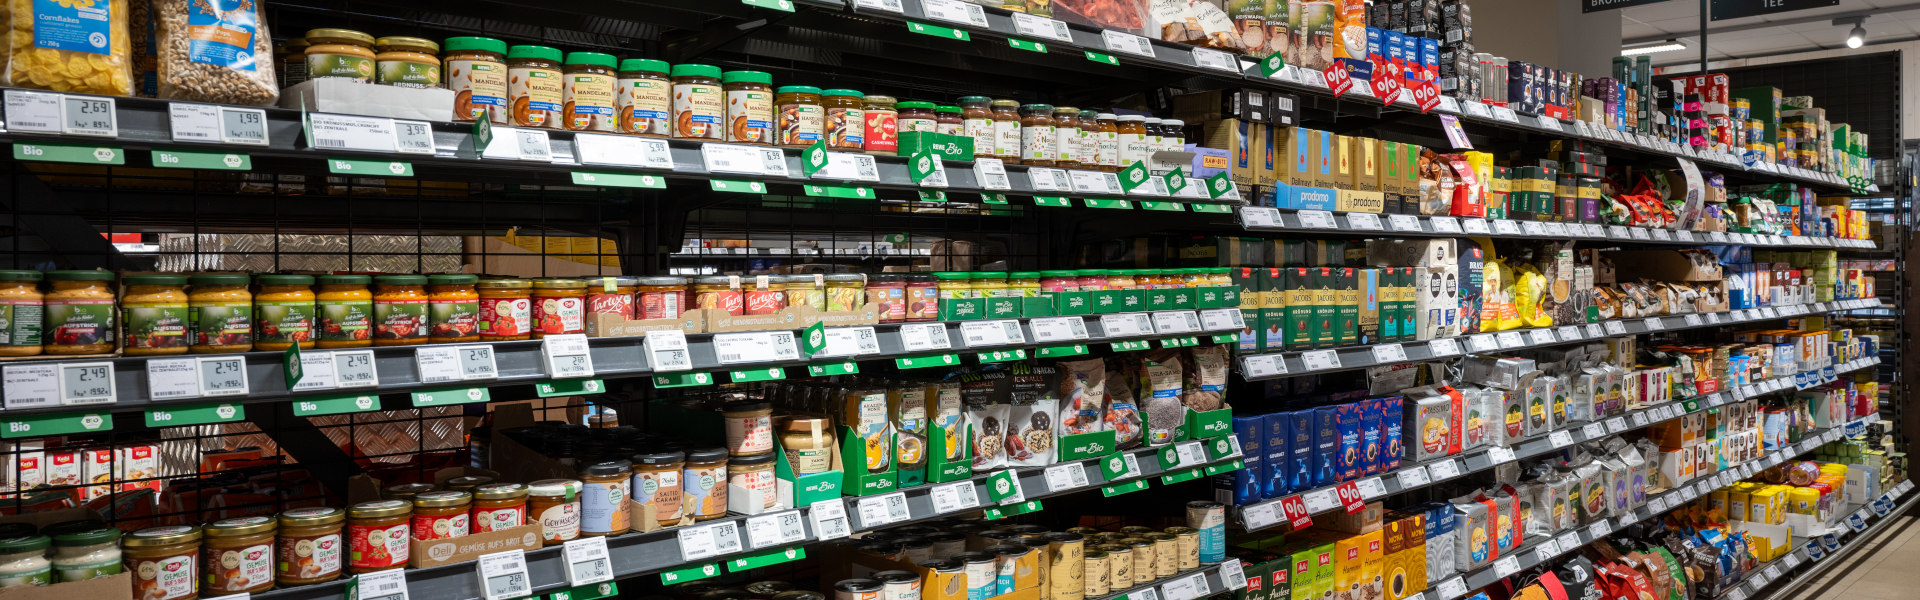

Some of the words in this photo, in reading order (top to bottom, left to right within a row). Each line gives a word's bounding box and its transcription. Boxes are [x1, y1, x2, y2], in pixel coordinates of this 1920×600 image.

[39, 14, 80, 24] Cornflakes
[1327, 66, 1347, 84] %
[1335, 79, 1351, 95] AKTION
[1377, 76, 1397, 93] %
[1384, 89, 1401, 104] AKTION
[1415, 85, 1435, 101] %
[1422, 97, 1439, 111] AKTION
[22, 145, 43, 156] Bio
[945, 142, 962, 155] Bio
[160, 154, 179, 163] Bio
[336, 161, 351, 170] Bio
[1233, 174, 1253, 184] Dallmayr
[1292, 177, 1312, 187] Dallmayr
[1315, 179, 1334, 189] Dallmayr
[1300, 191, 1329, 203] prodomo
[1353, 197, 1381, 209] prodomo
[591, 294, 625, 312] Tartex
[746, 292, 776, 310] Tartex
[1265, 296, 1284, 305] JACOBS
[1293, 294, 1311, 302] JACOBS
[1317, 294, 1335, 302] JACOBS
[1341, 294, 1358, 302] JACOBS
[735, 371, 746, 379] Bio
[418, 394, 433, 402] Bio
[300, 402, 317, 411] Bio
[153, 411, 172, 421] Bio
[10, 422, 30, 432] Bio
[1215, 421, 1228, 431] Bio
[1087, 442, 1104, 454] Bio
[954, 466, 968, 475] Bio
[818, 482, 835, 492] Bio
[877, 478, 892, 489] Bio
[1340, 486, 1359, 502] %
[1286, 499, 1304, 517] %
[1347, 500, 1364, 512] AKTION
[1293, 516, 1310, 528] AKTION
[390, 539, 407, 547] GEMÜSE
[459, 542, 486, 553] GEMÜSE
[504, 537, 520, 546] BROT
[249, 551, 260, 559] Deli
[319, 548, 338, 557] GEMÜSE
[433, 545, 451, 555] Deli
[246, 560, 267, 569] GEMÜSE
[164, 571, 188, 581] GEMÜSE
[665, 573, 677, 581] Bio
[1316, 568, 1333, 581] Auslese
[1294, 577, 1312, 589] Auslese
[556, 592, 568, 600] Bio
[1270, 587, 1290, 599] Auslese
